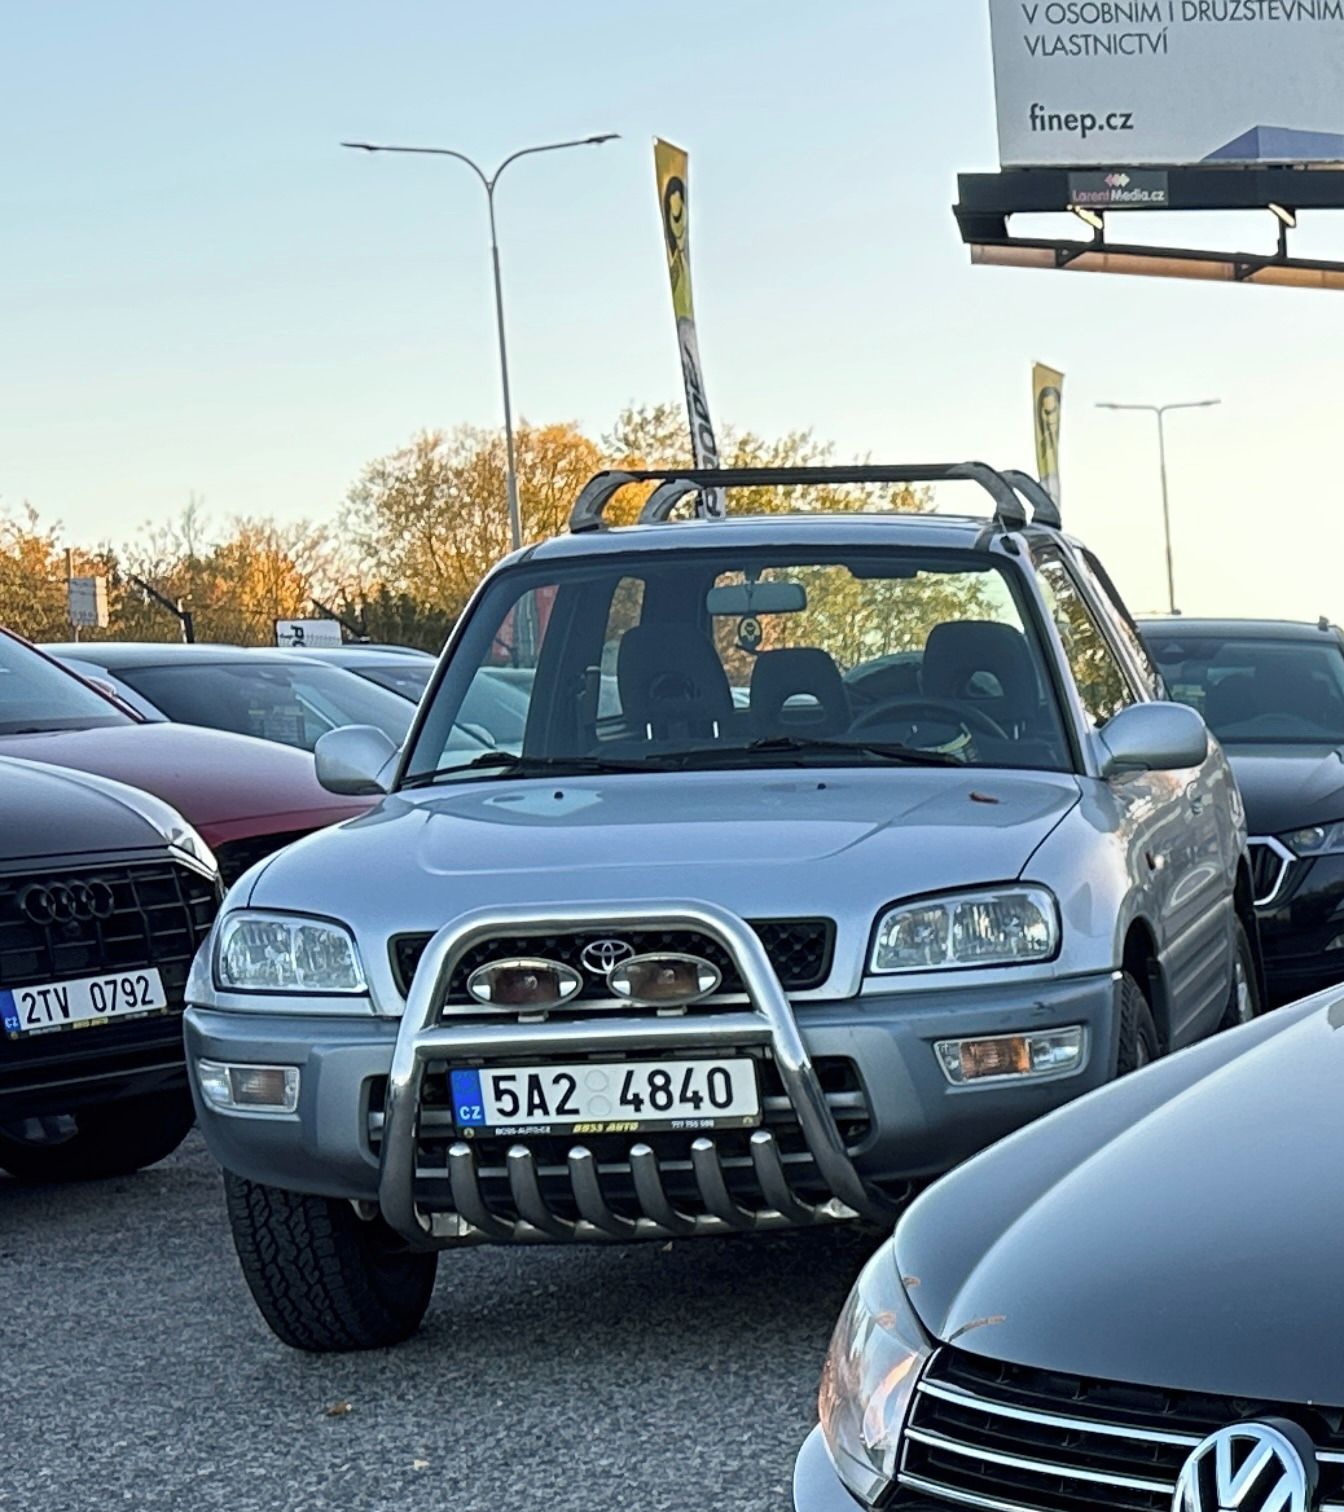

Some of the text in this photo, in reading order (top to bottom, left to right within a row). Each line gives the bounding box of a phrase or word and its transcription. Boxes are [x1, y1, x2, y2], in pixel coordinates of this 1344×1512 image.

[1021, 3, 1038, 24] V
[1168, 1, 1174, 23] I
[1023, 27, 1169, 57] VLASTNICTVÍ
[1029, 102, 1135, 139] finep.cz
[21, 975, 154, 1025] 2TV 0792
[491, 1066, 734, 1118] 5A2 4840
[460, 1105, 482, 1121] CZ
